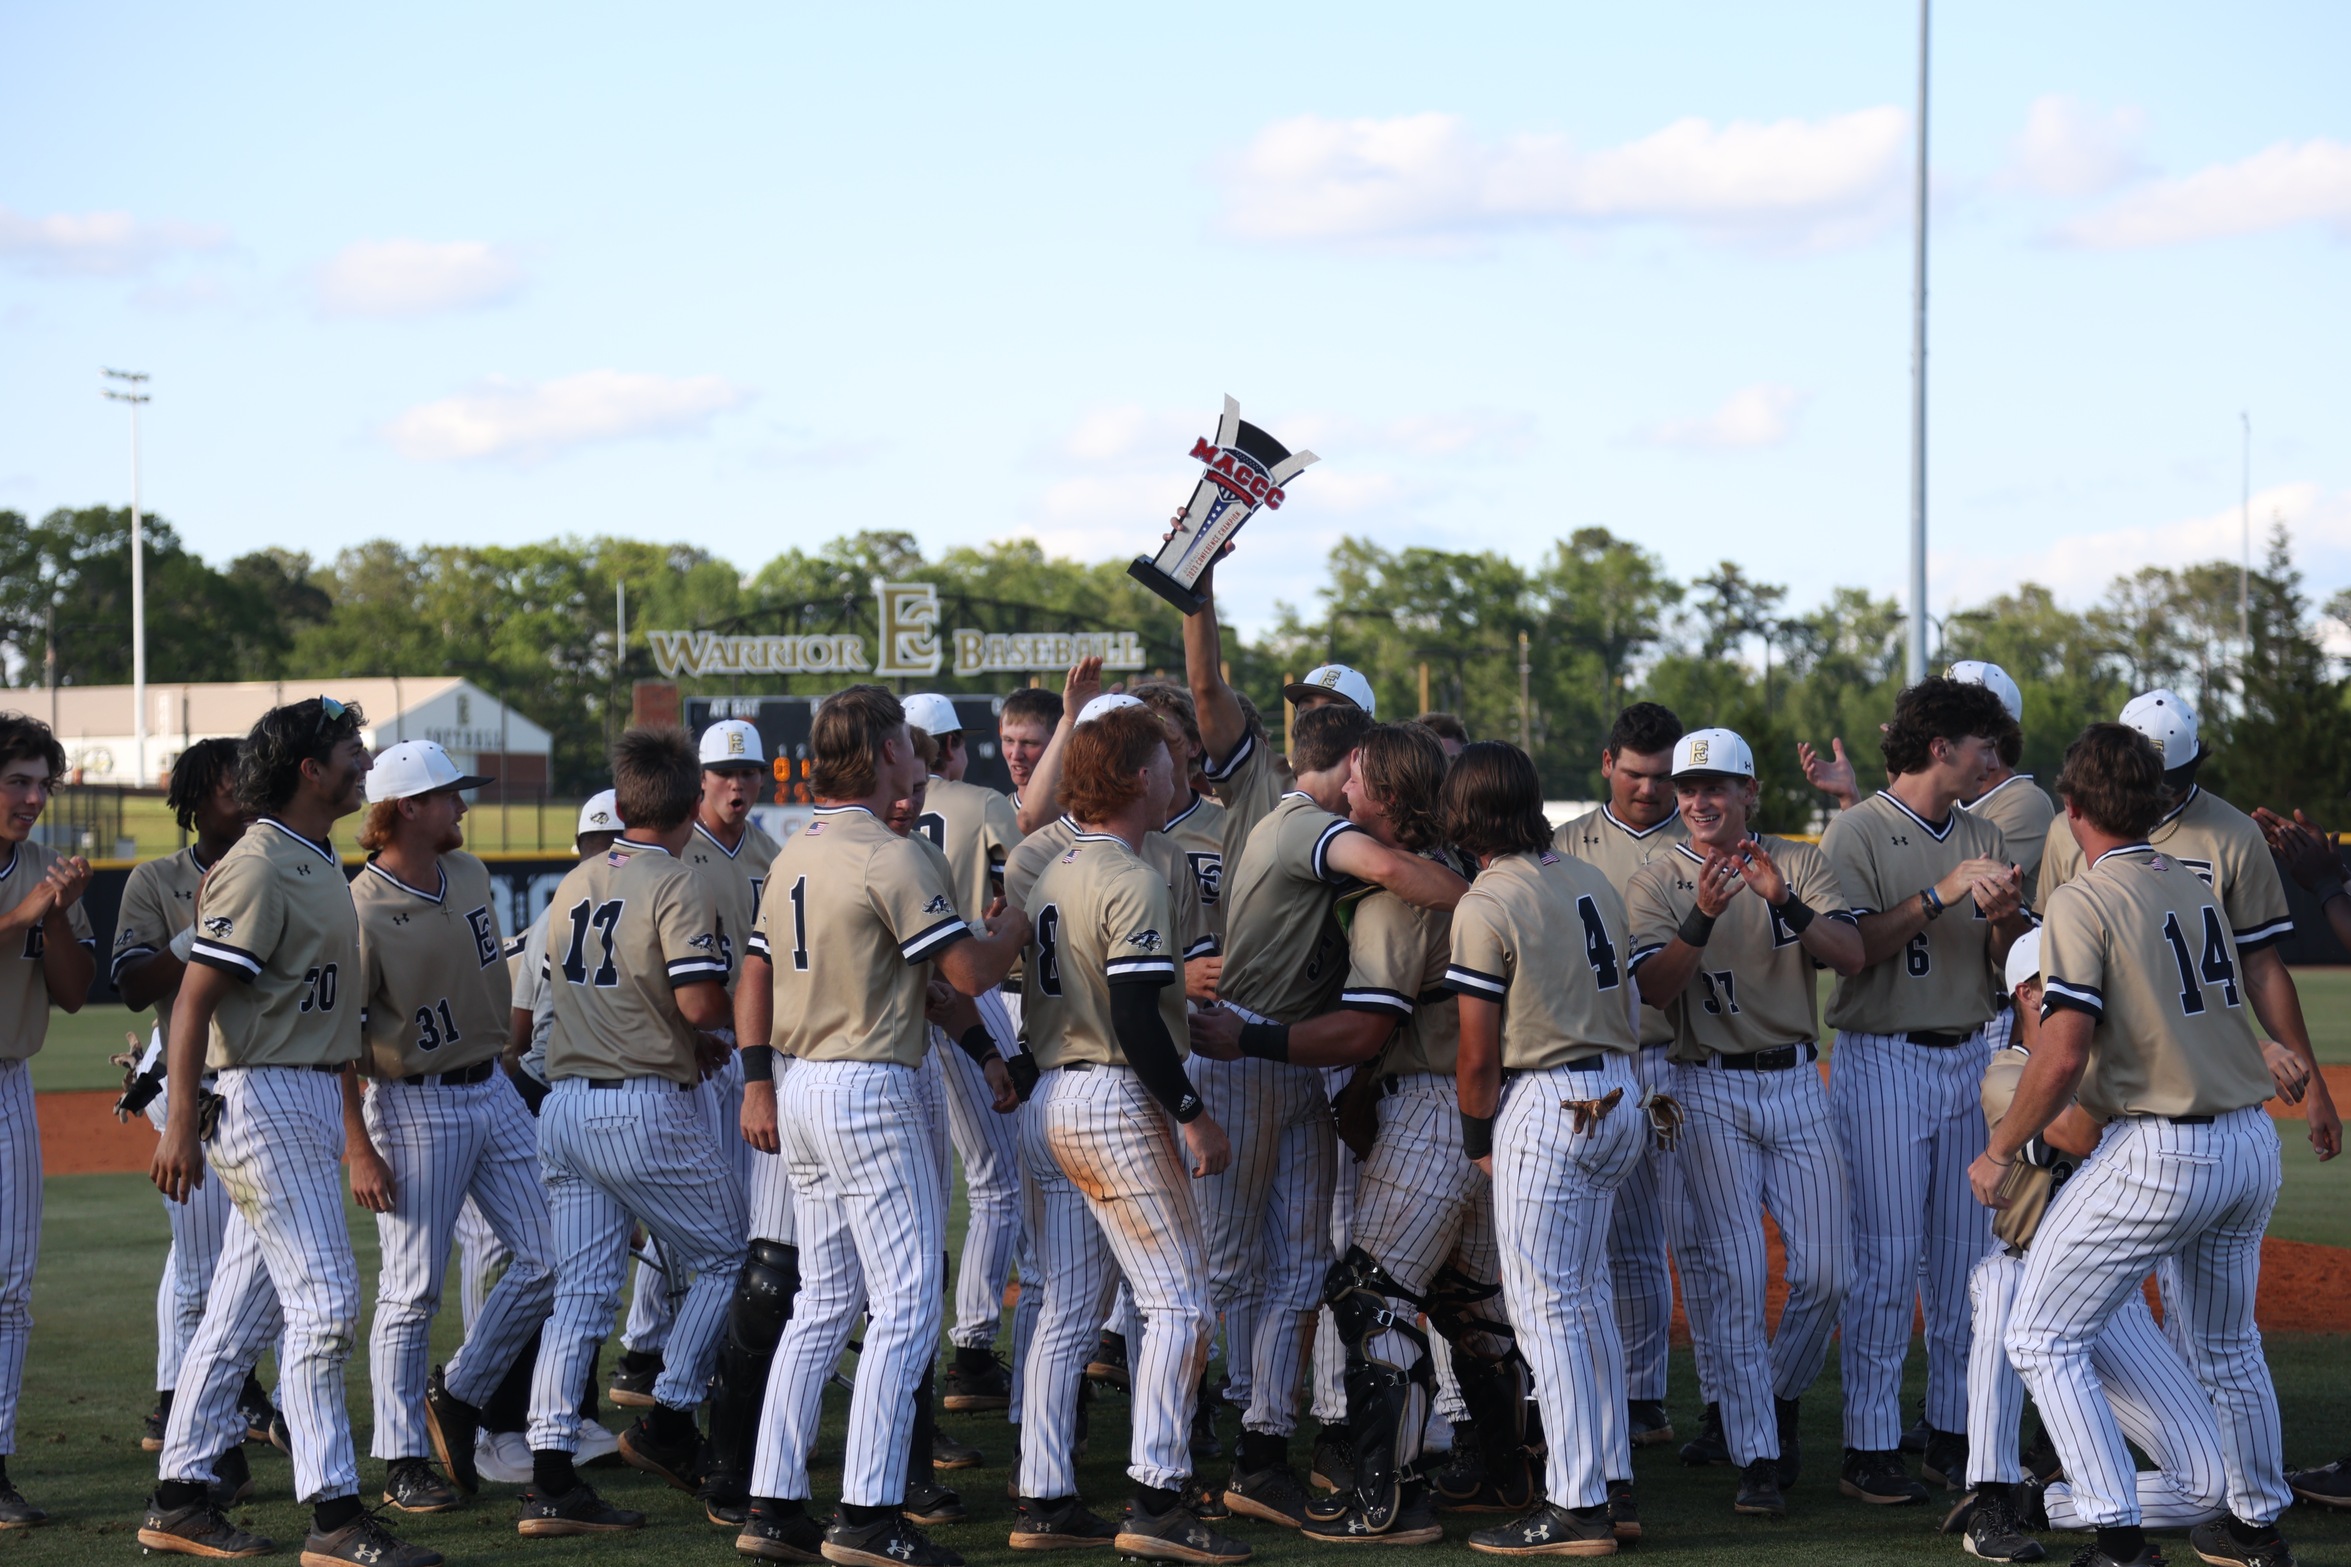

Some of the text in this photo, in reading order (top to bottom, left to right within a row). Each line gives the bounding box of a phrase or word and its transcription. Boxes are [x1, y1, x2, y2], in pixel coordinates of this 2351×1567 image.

[1189, 436, 1285, 510] MACCC
[1186, 565, 1198, 579] 2023
[1196, 535, 1220, 566] CONFERENCE
[1218, 511, 1241, 536] CHAMPION
[647, 628, 1146, 679] WARRIOR BASEBALL
[562, 897, 625, 988] 17
[790, 874, 809, 971] 1
[1576, 894, 1619, 992] 4
[1905, 931, 1931, 978] 6
[300, 962, 338, 1012] 30
[1702, 969, 1741, 1015] 37
[2162, 905, 2241, 1016] 14
[415, 997, 461, 1051] 31
